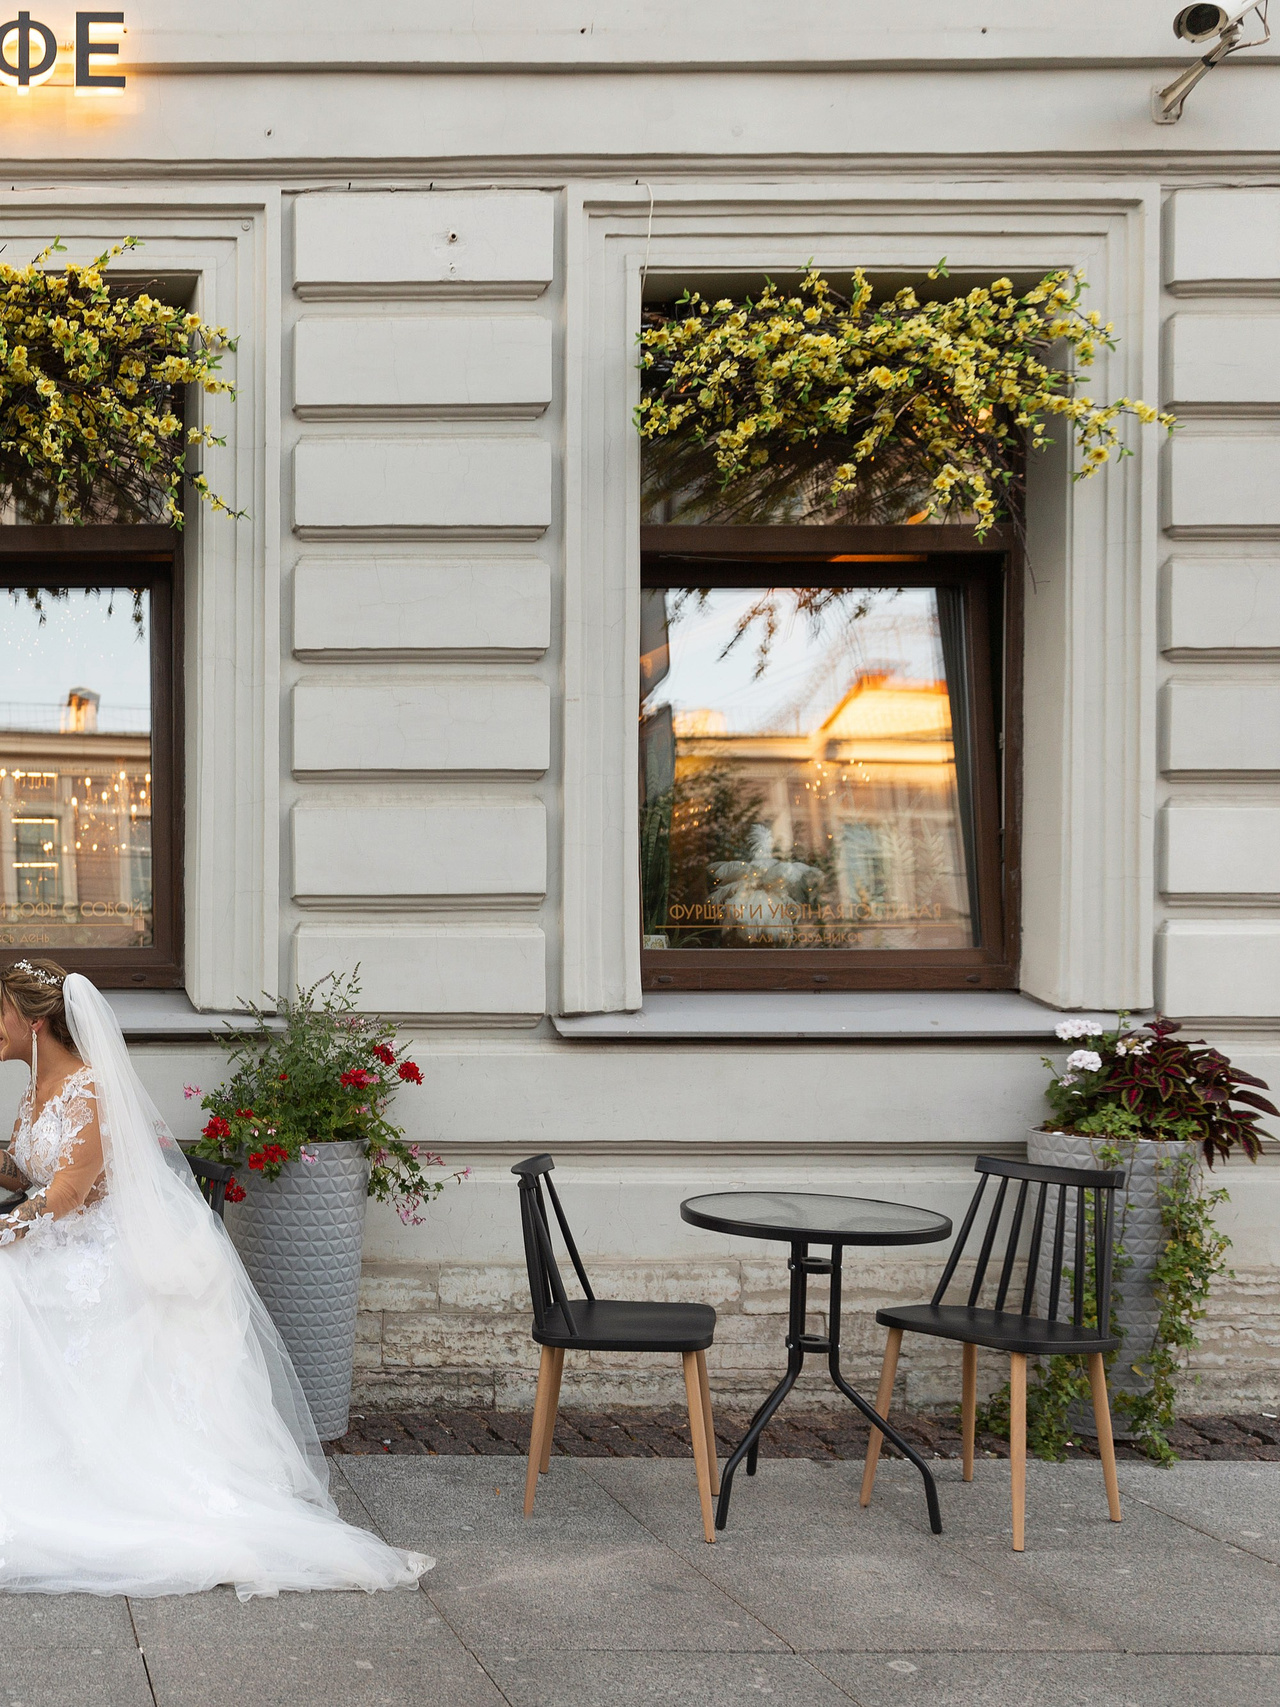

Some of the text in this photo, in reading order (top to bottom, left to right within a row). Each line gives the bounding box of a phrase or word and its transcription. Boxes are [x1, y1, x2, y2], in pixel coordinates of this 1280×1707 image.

[11, 901, 58, 918] КОФЕ
[62, 901, 75, 918] С
[80, 898, 143, 918] СОБОЙ
[669, 902, 941, 920] ФУРШЕТЫ И УЮТНАЯ ГОСТИНАЯ
[20, 933, 50, 944] день
[750, 932, 863, 944] для праздников
